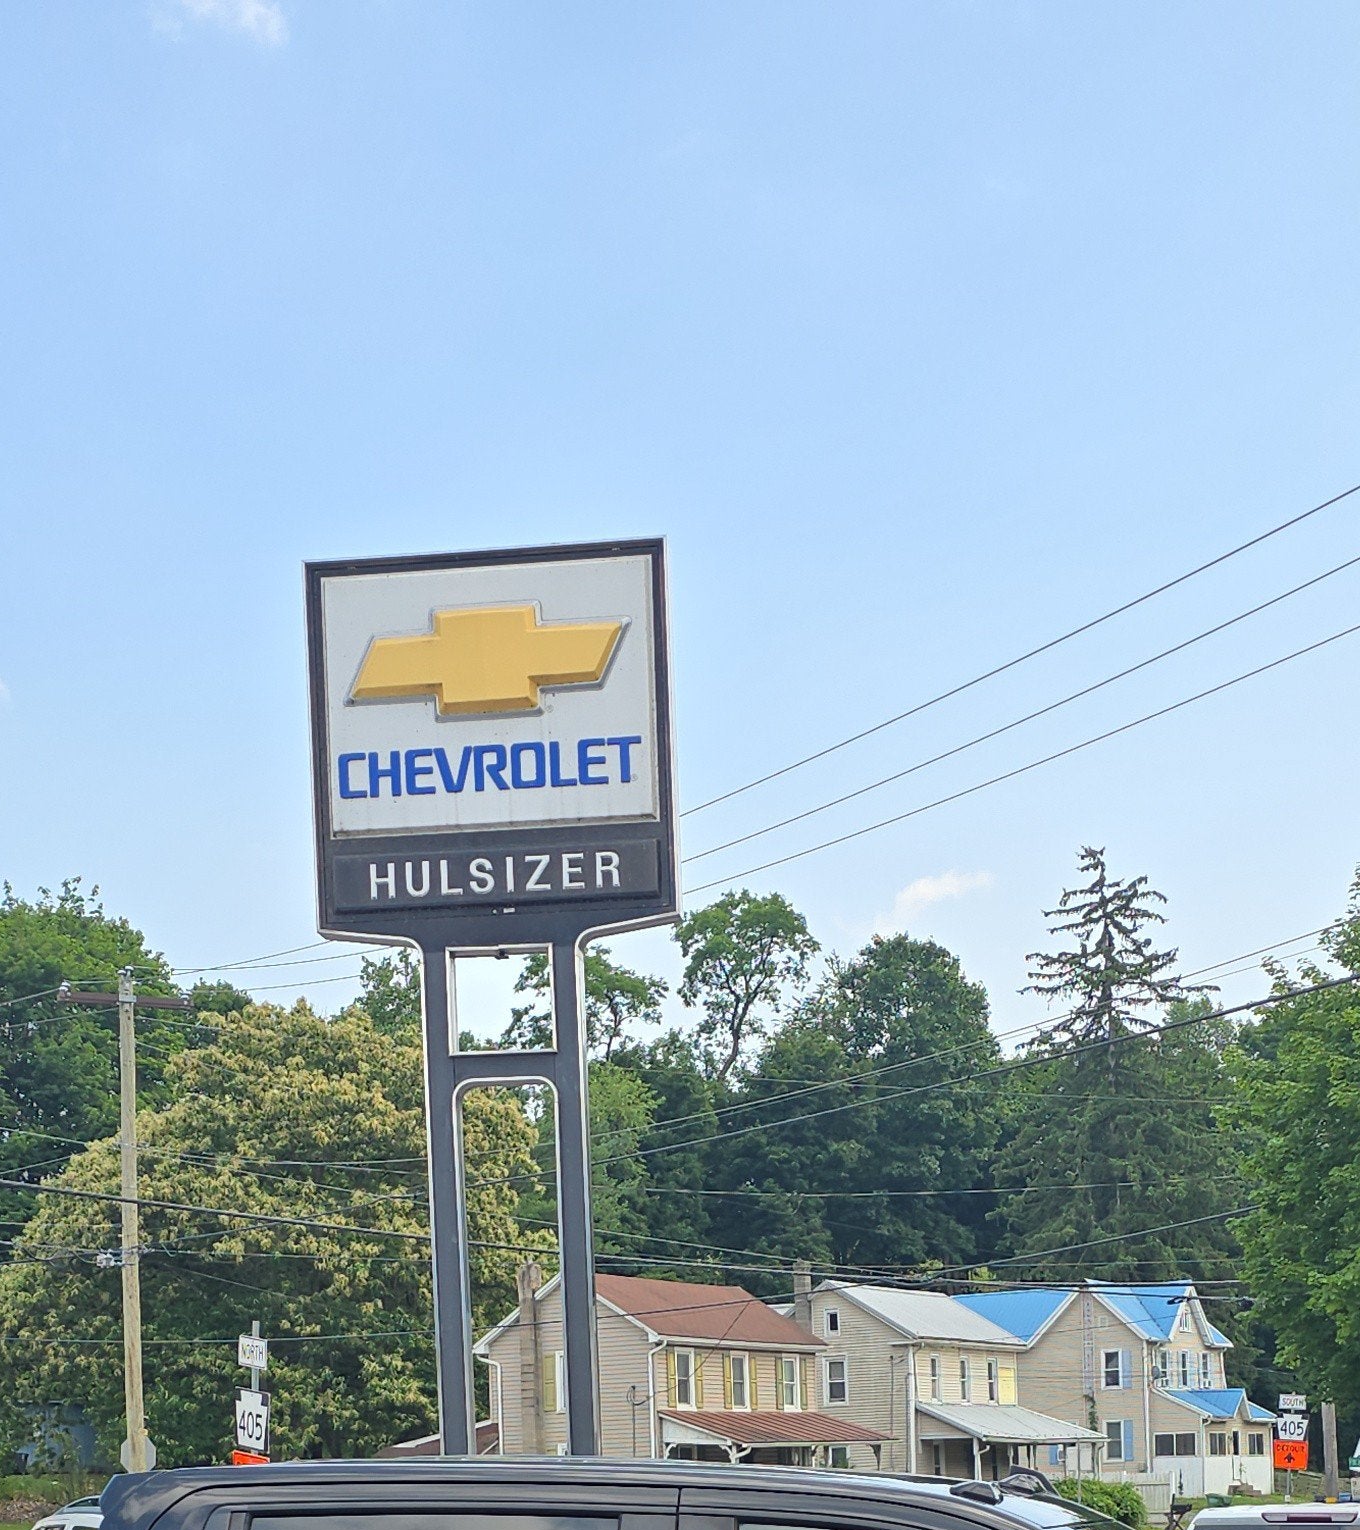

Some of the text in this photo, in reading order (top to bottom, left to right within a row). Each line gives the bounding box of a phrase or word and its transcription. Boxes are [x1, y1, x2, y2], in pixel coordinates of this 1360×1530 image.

[338, 735, 642, 799] CHEVROLET
[369, 851, 621, 900] HULSIZER
[242, 1343, 264, 1361] NORTH
[1282, 1397, 1304, 1407] SOUTH
[239, 1410, 263, 1441] 405
[1280, 1420, 1304, 1436] 405
[1276, 1444, 1305, 1453] DETOUR
